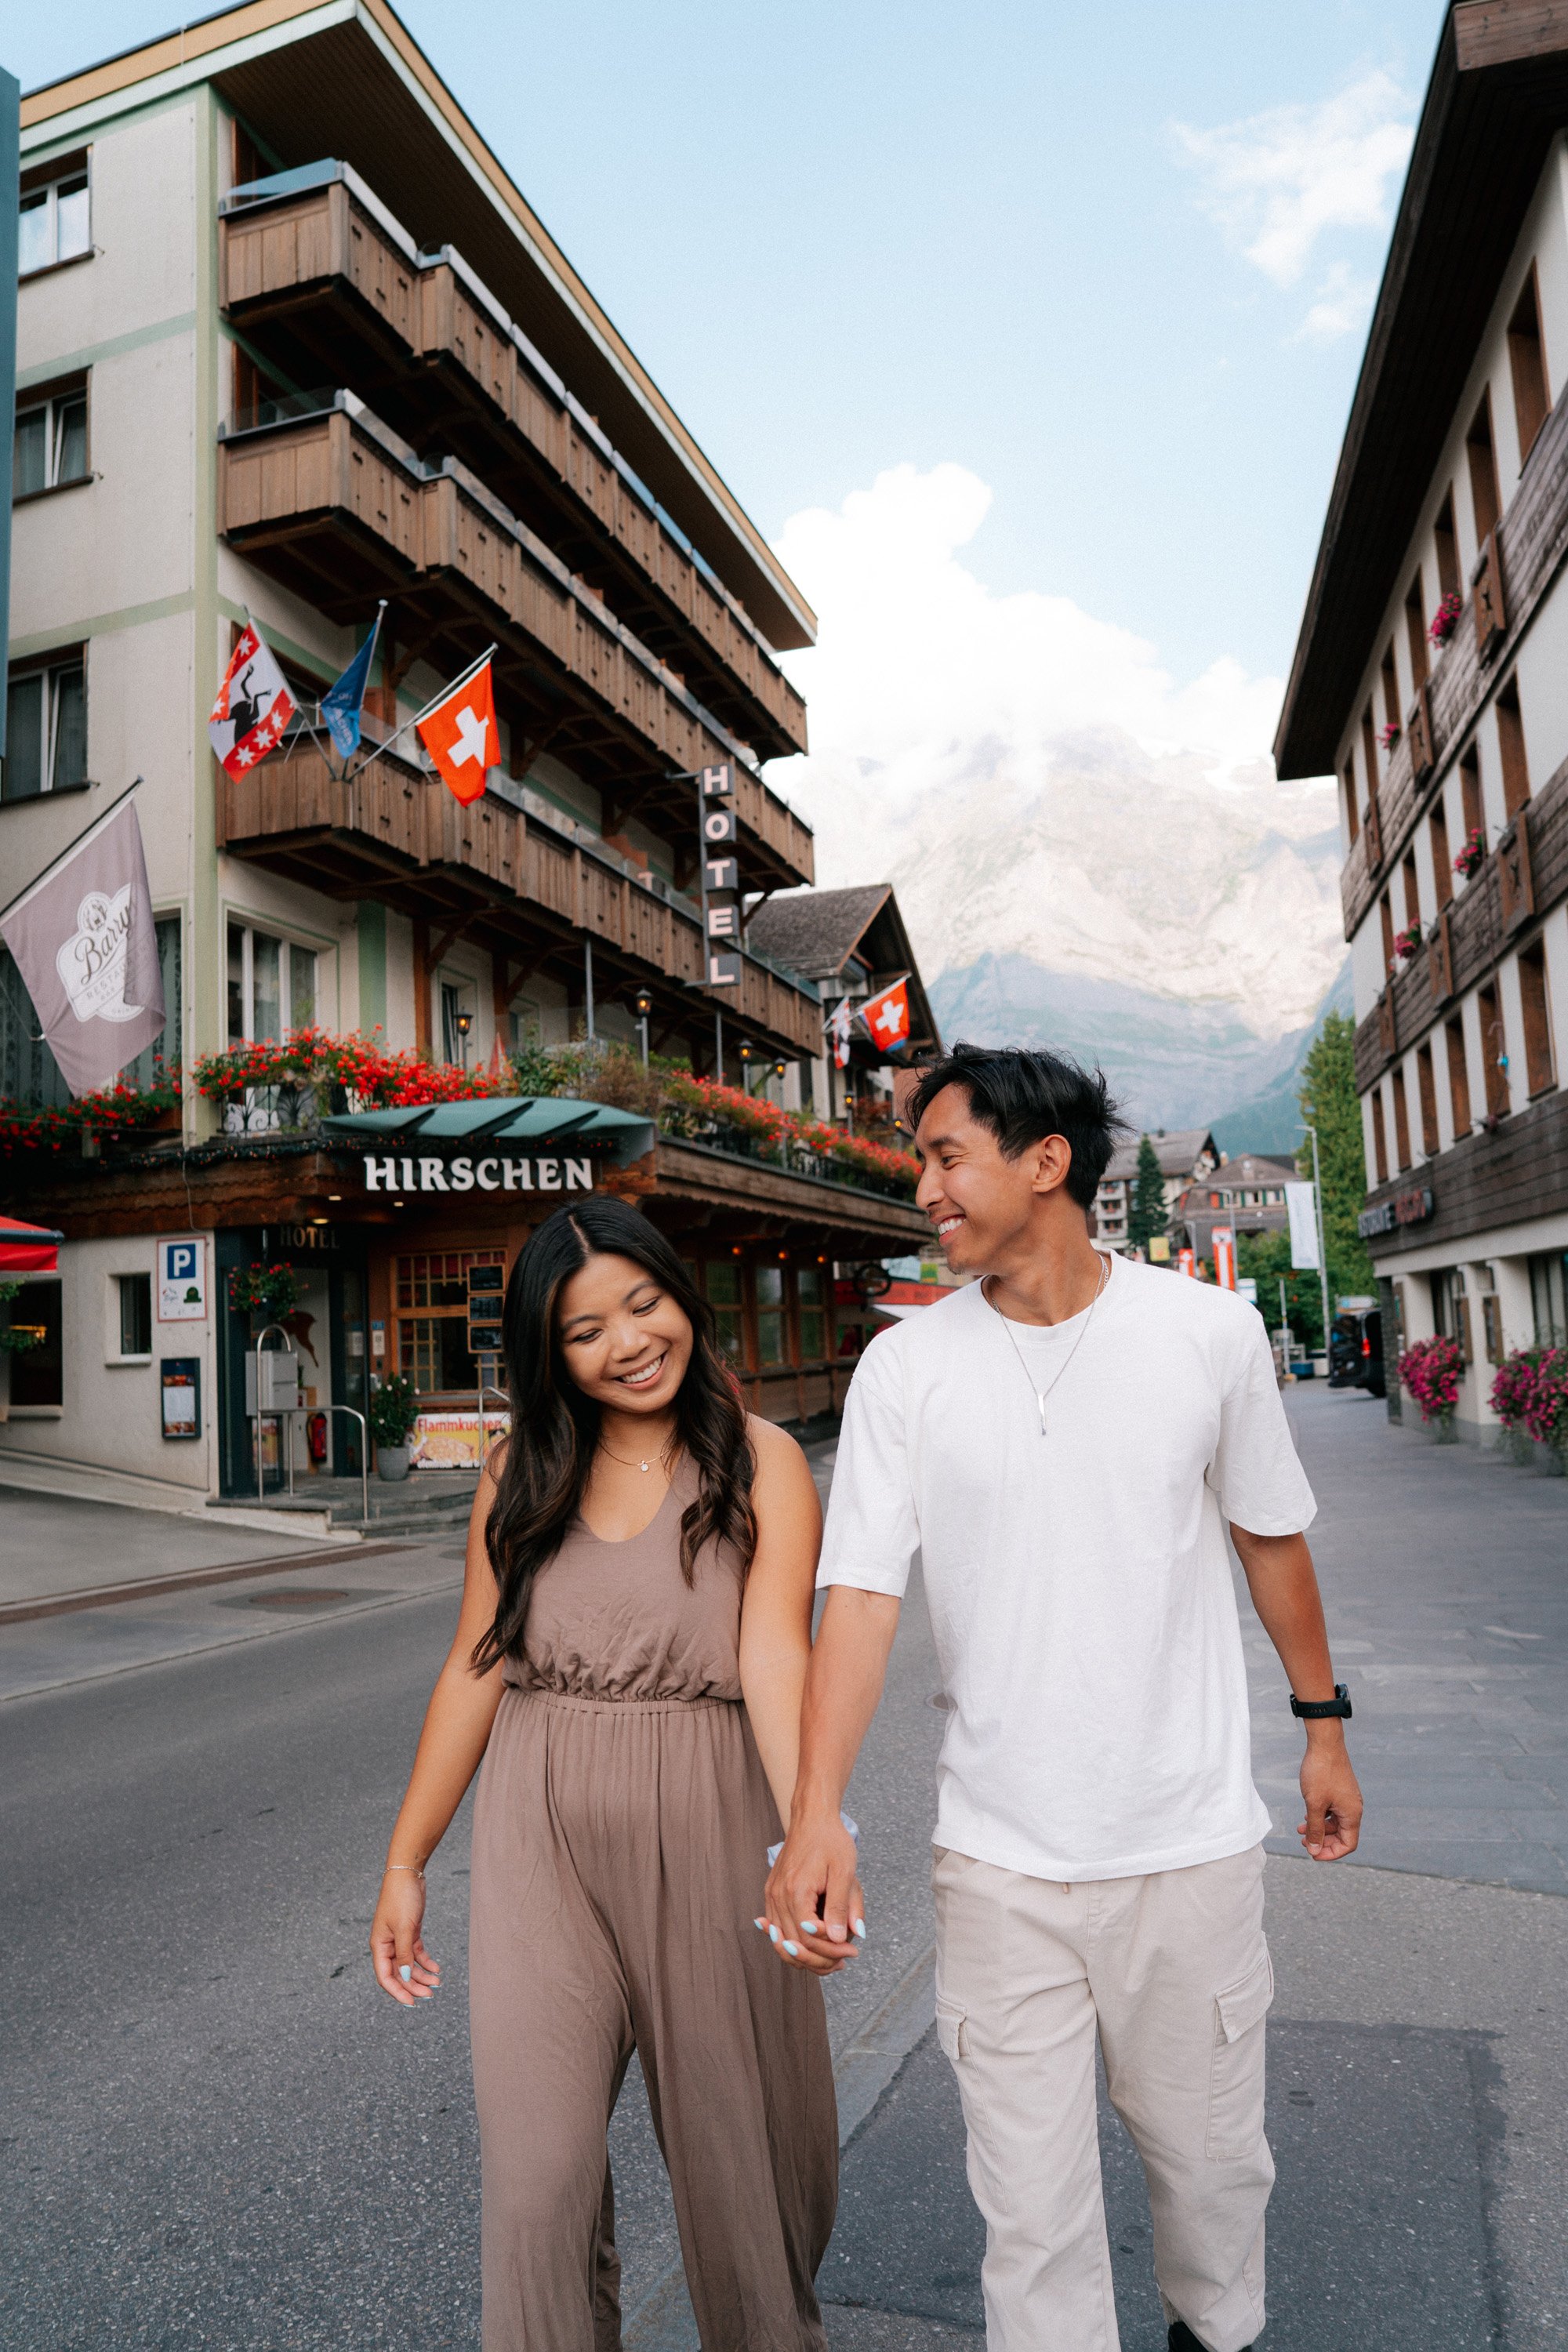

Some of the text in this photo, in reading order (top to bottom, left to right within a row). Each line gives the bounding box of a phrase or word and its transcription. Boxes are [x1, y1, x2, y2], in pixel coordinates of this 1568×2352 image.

[703, 765, 735, 984] HOTEL
[363, 1156, 593, 1192] HIRSCHEN
[280, 1225, 339, 1249] HOTEL
[173, 1248, 191, 1277] P
